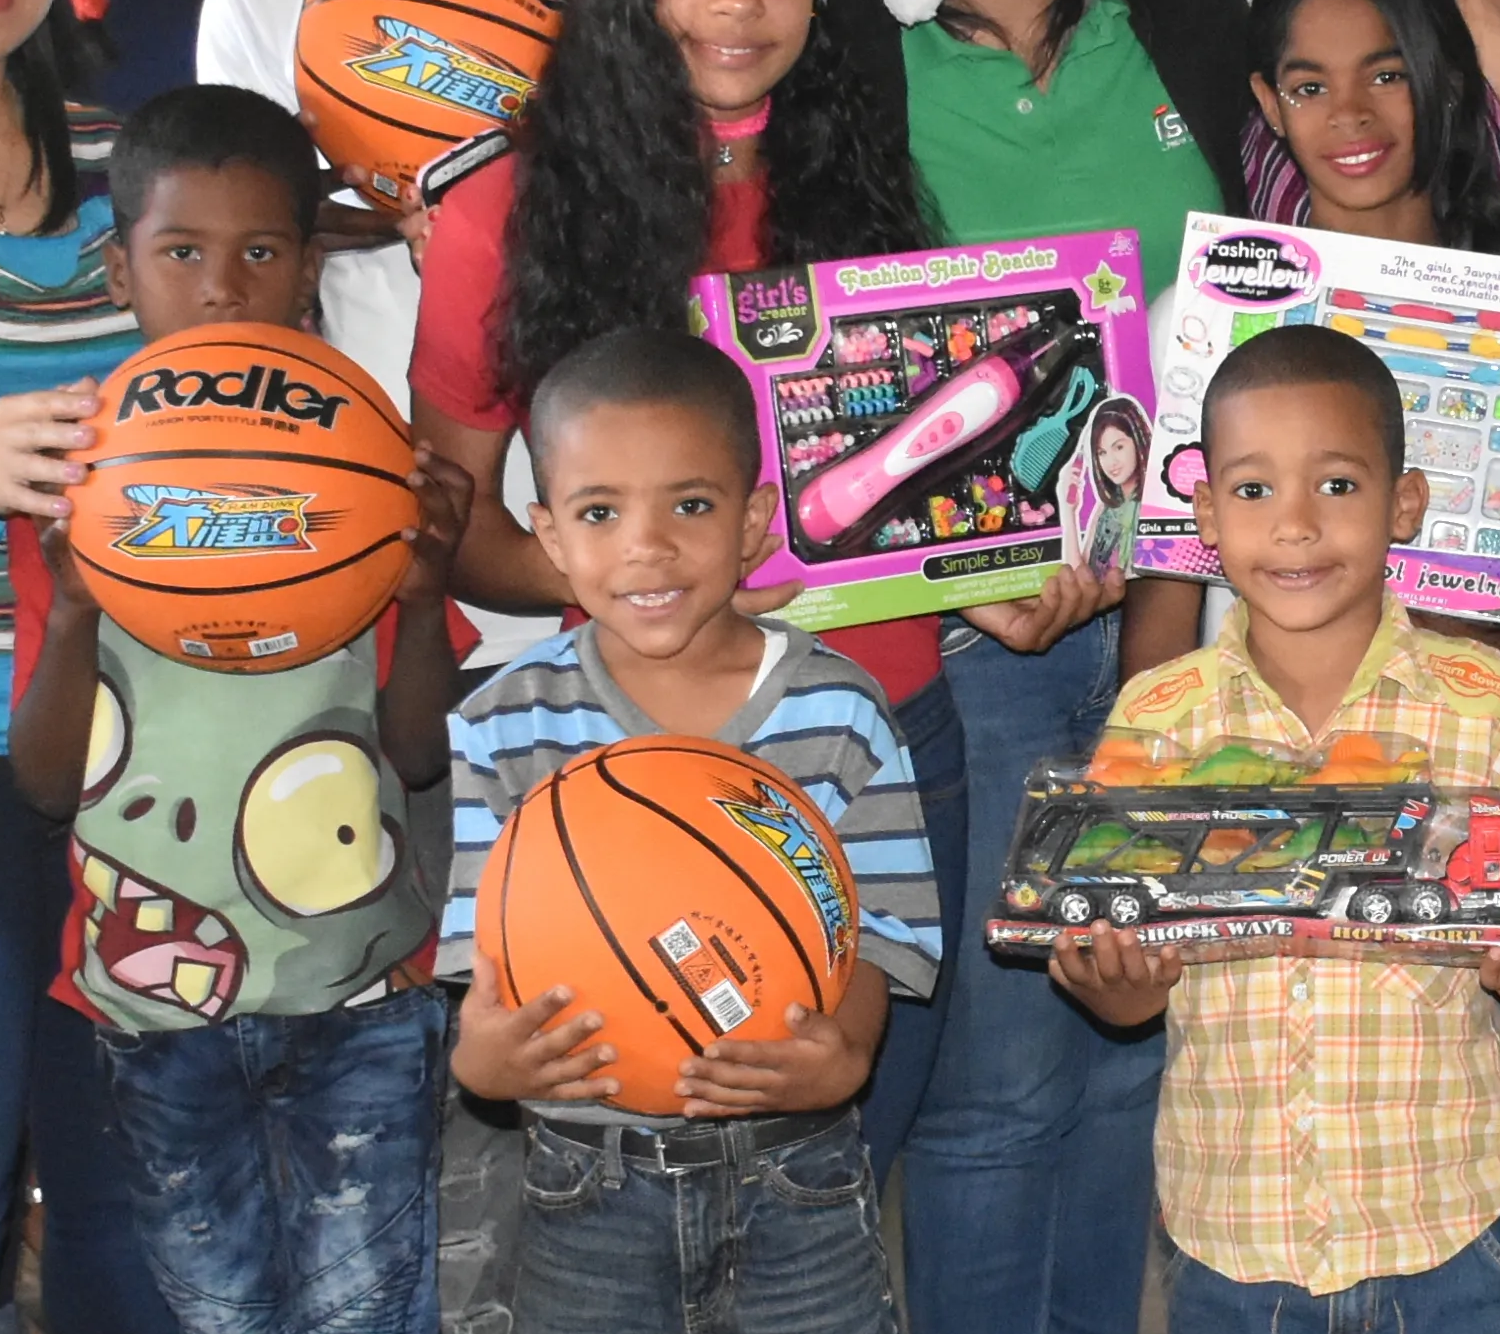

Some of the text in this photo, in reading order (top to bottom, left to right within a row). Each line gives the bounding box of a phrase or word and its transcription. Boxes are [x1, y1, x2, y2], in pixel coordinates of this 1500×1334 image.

[1208, 240, 1278, 261] Fashion
[837, 247, 1058, 295] Fashion Hair Beader
[1394, 255, 1416, 269] The
[1426, 261, 1453, 275] girls
[1188, 256, 1316, 298] Jewellery
[737, 275, 808, 324] girl's
[115, 364, 350, 431] Rodler
[1139, 523, 1162, 535] Girls
[1183, 522, 1198, 533] lik
[941, 545, 1045, 574] Simple & Easy
[1318, 849, 1390, 864] POWERUL
[1136, 919, 1294, 942] SHOCK WAVE
[1331, 924, 1387, 943] HOT
